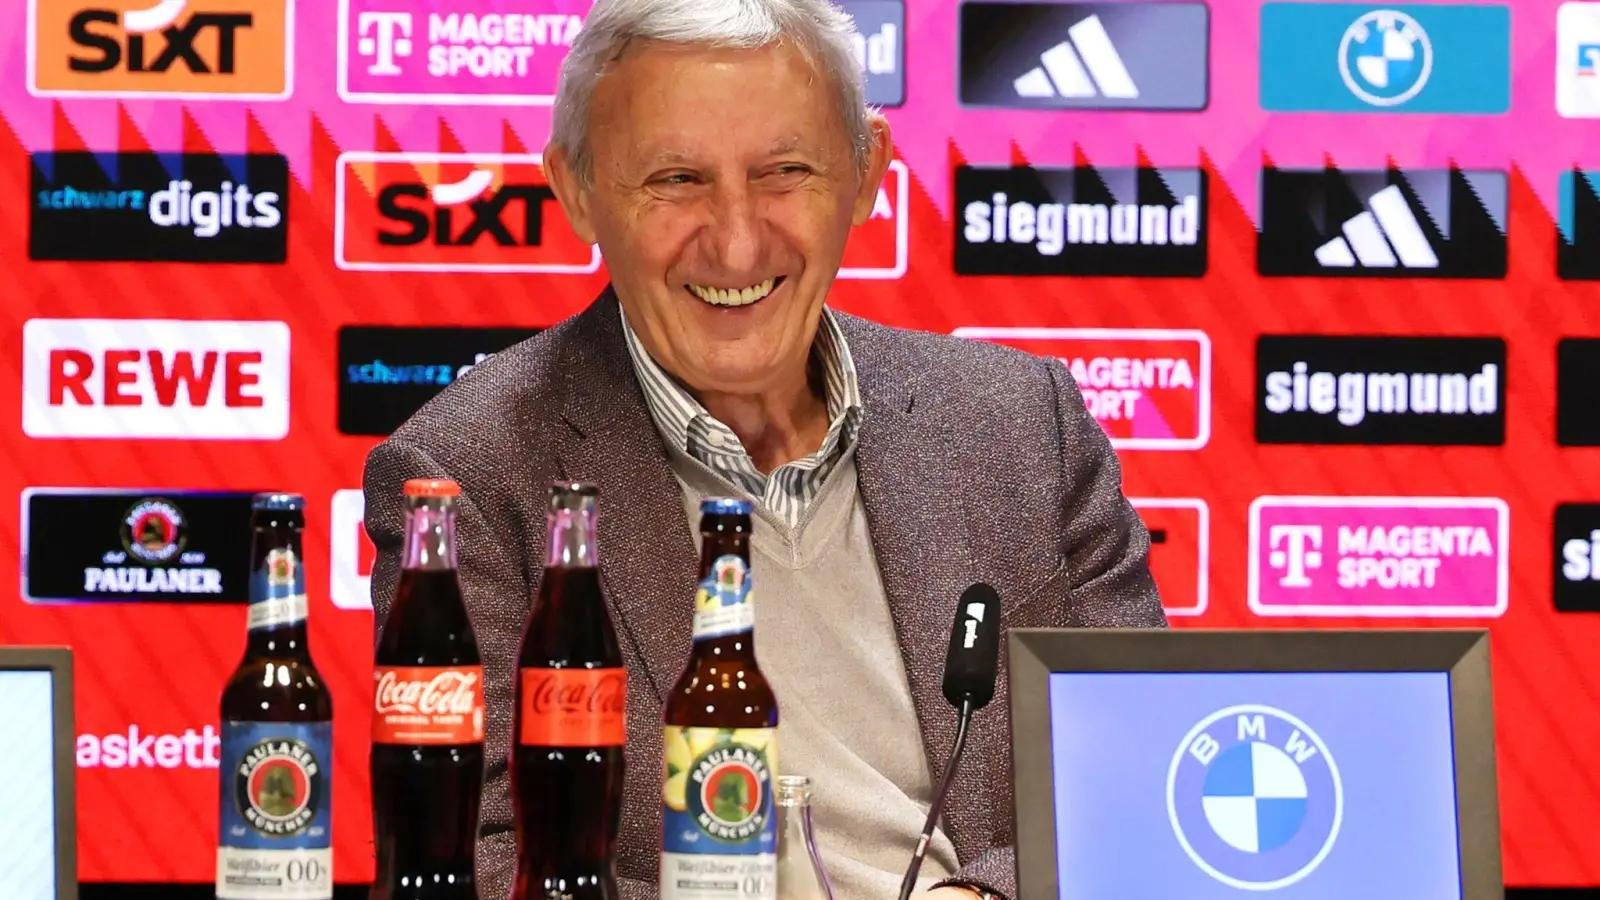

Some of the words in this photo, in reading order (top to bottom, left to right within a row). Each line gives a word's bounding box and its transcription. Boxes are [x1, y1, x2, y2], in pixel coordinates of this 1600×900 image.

[428, 12, 583, 46] MAGENTA
[428, 45, 534, 77] SPORT
[149, 180, 281, 236] digits
[963, 193, 1199, 255] siegmund
[49, 349, 263, 408] REWE
[1265, 362, 1498, 426] siegmund
[1083, 388, 1142, 420] ORT
[1337, 525, 1492, 557] MAGENTA
[84, 567, 223, 593] PAULANER
[1337, 557, 1440, 589] SPORT
[375, 671, 477, 714] Coca-Cola
[1189, 715, 1317, 766] BMW
[240, 742, 317, 777] PAULANER
[692, 748, 768, 783] PAULANER
